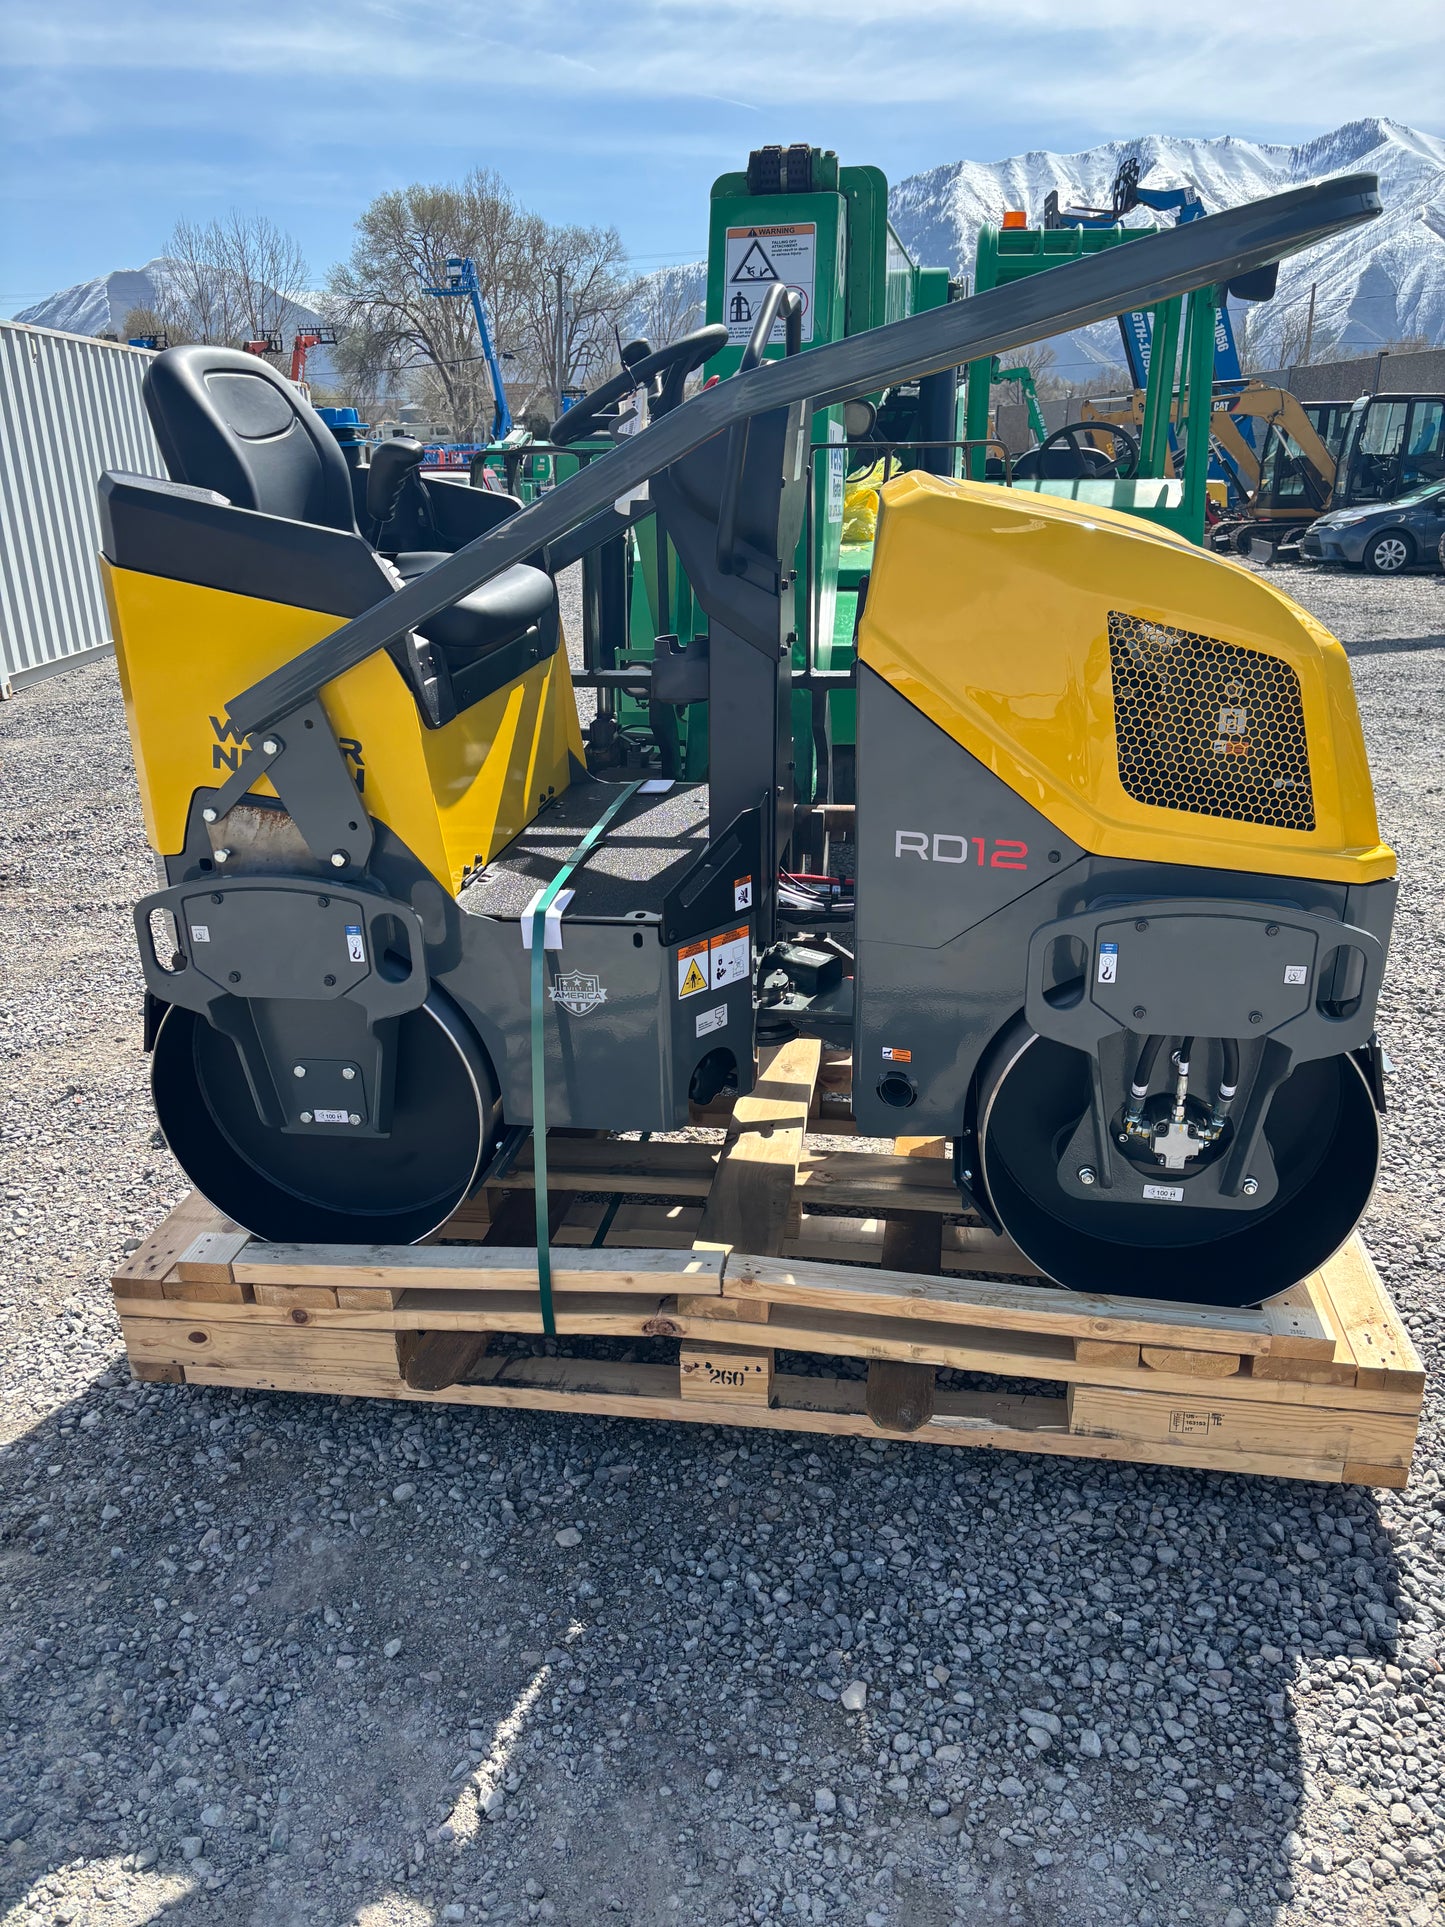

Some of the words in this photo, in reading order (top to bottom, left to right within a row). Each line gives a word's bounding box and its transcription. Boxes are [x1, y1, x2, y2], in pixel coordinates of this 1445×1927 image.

[758, 227, 795, 235] WARNING
[1131, 311, 1152, 376] GTH-105
[1213, 401, 1230, 412] CAT
[894, 830, 1029, 871] RD12
[553, 991, 602, 1000] AMERICA
[709, 1369, 745, 1386] 260
